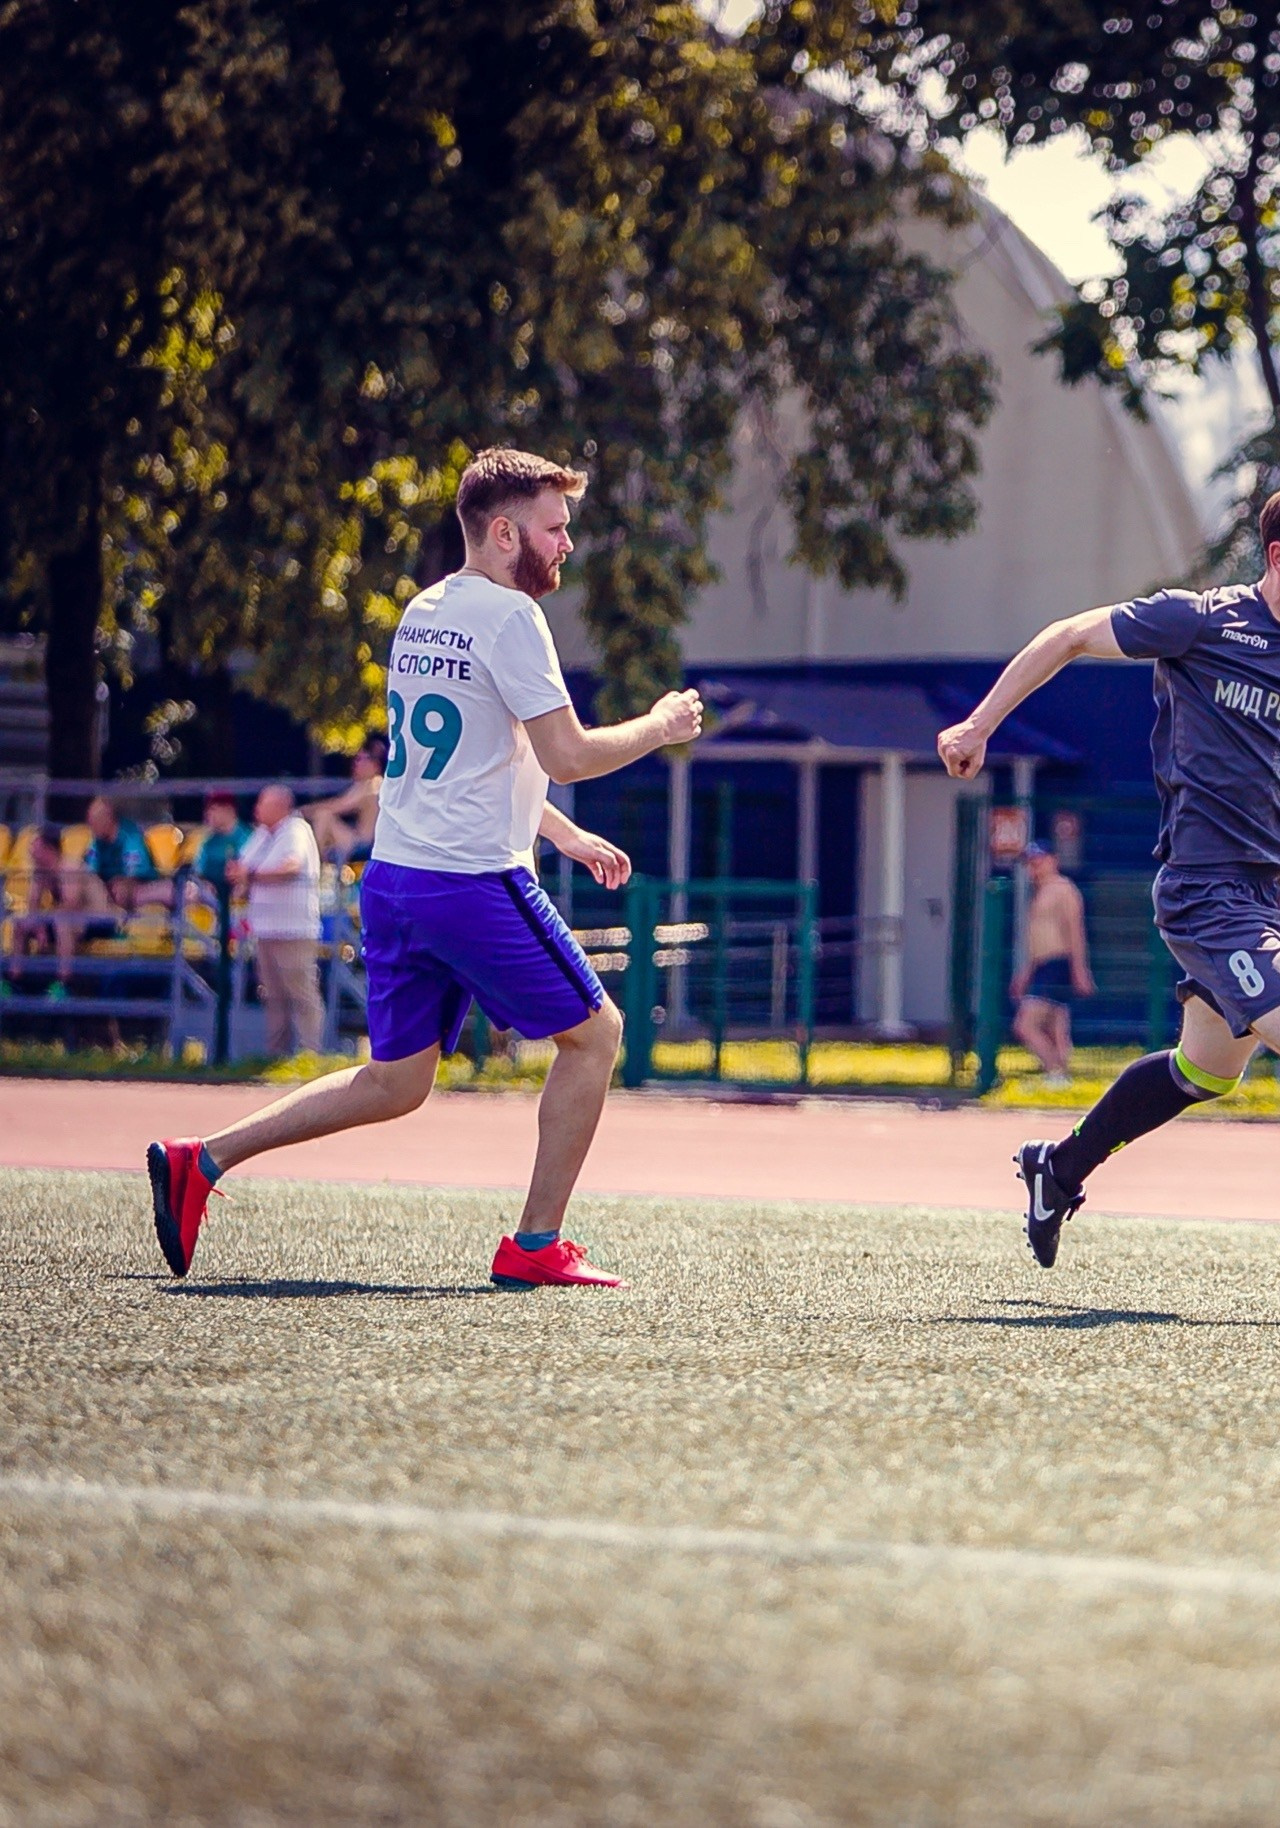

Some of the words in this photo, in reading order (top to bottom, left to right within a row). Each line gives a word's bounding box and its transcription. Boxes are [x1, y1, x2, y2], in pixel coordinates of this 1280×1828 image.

[1221, 628, 1269, 650] macron
[397, 653, 471, 681] СПОРТЕ
[1214, 678, 1263, 719] МИД
[1228, 950, 1265, 998] 8
